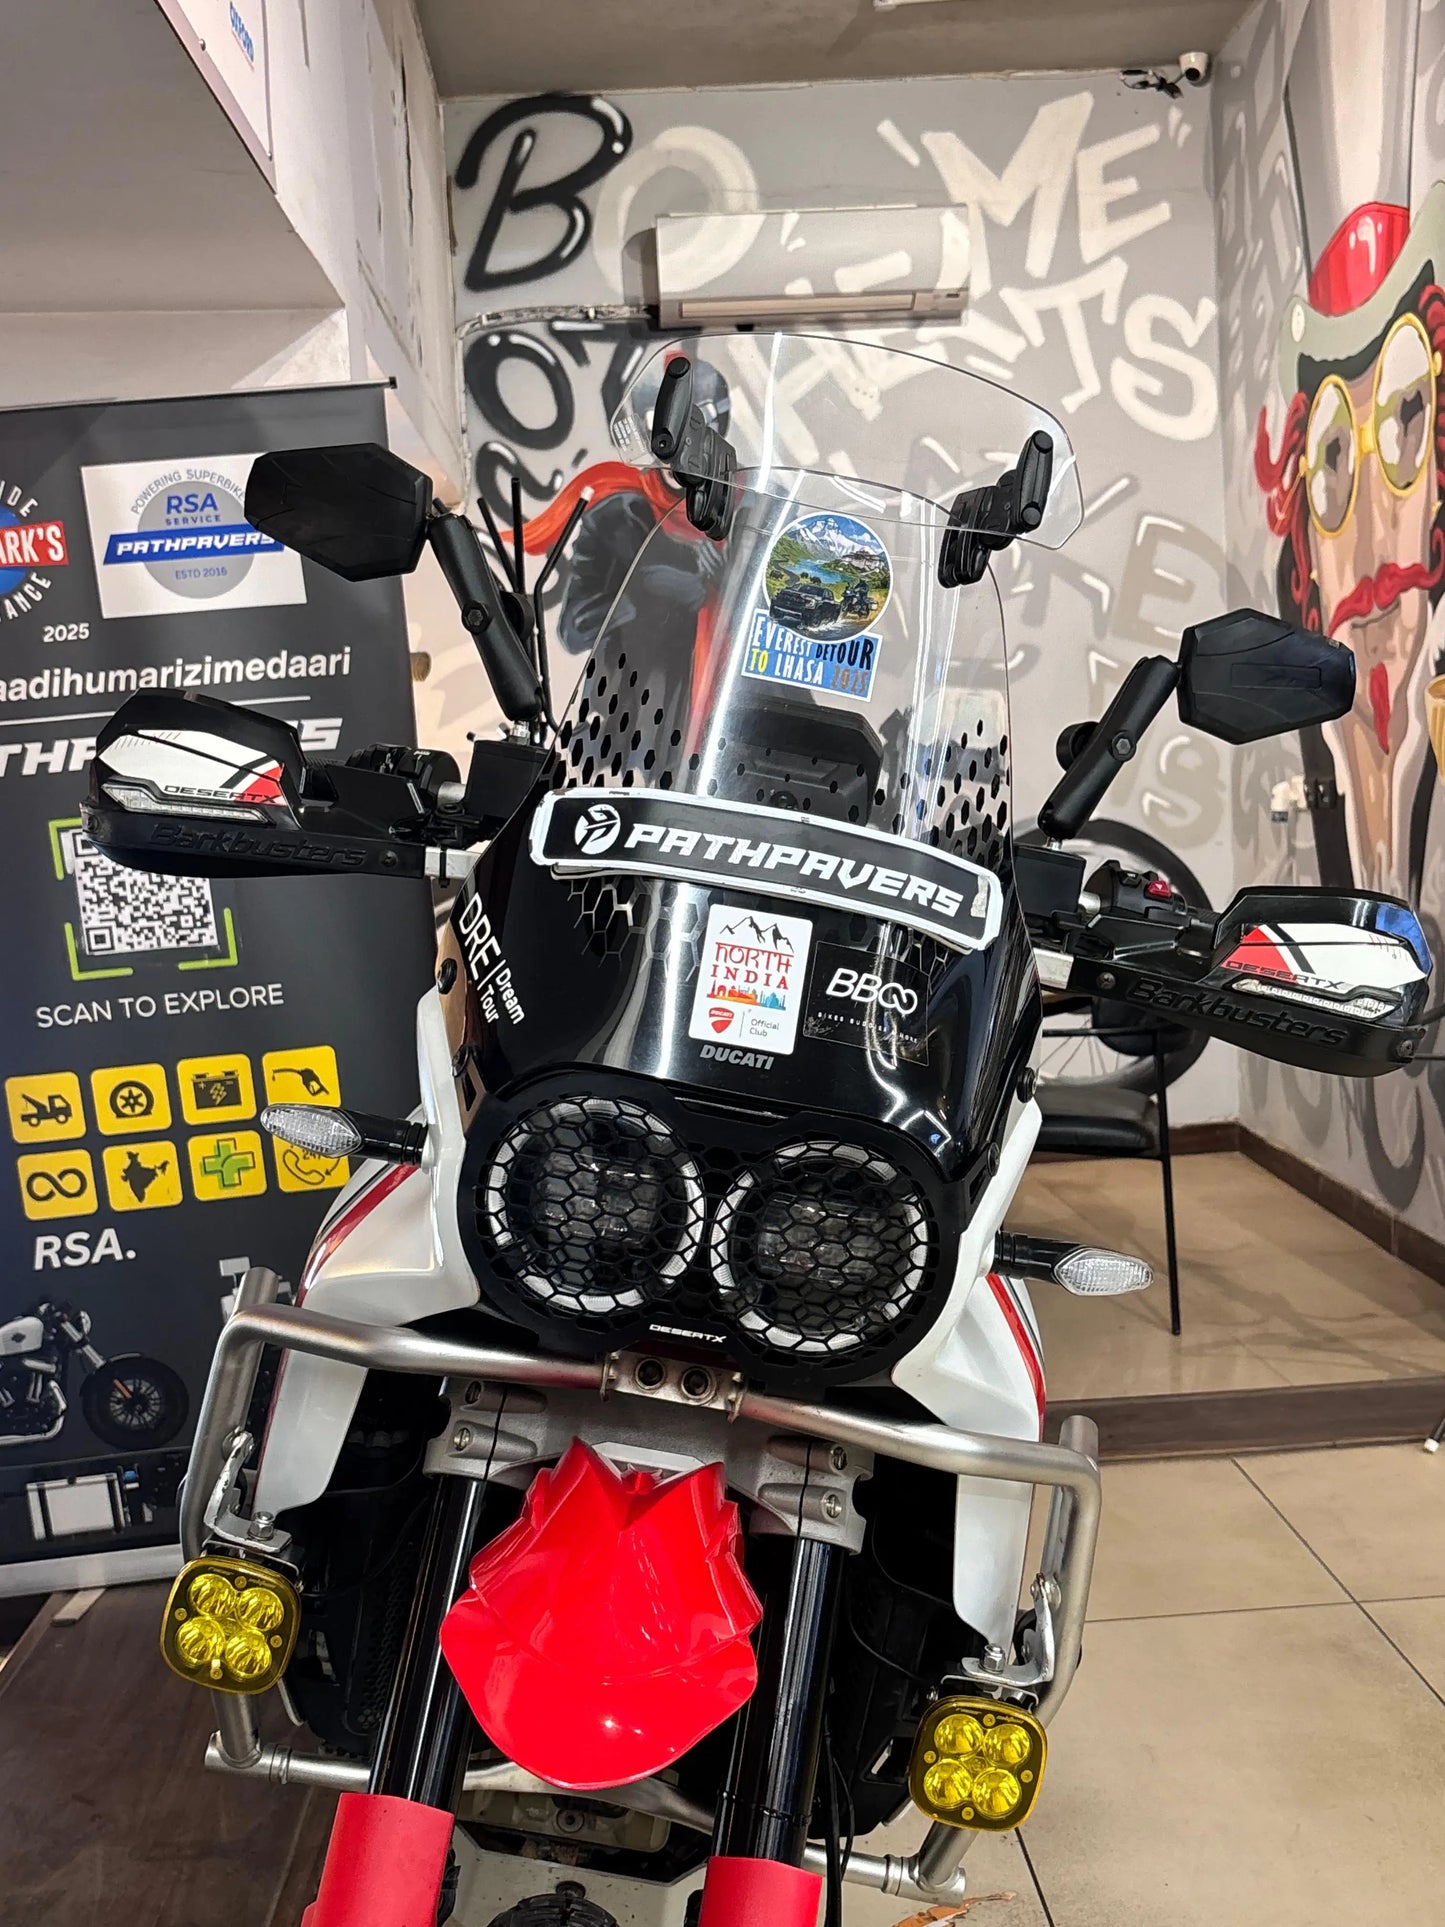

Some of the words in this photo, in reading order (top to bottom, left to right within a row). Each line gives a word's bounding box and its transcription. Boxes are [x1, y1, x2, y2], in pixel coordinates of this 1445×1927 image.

[131, 471, 183, 515] POWERING
[166, 493, 219, 515] RSA
[165, 514, 222, 526] SERVICE
[175, 569, 201, 580] ESTD
[43, 622, 90, 643] 2025
[752, 616, 813, 657] EVEREST
[816, 638, 874, 671] DETOUR
[750, 647, 769, 672] TO
[775, 654, 824, 685] LHASA
[830, 665, 868, 693] 2025
[151, 823, 367, 866] Barkbusters
[624, 822, 965, 917] PATHPAVERS
[459, 892, 501, 981] DRE
[495, 967, 525, 1025] Dream
[711, 964, 788, 990] INDIA
[36, 1001, 112, 1029] SCAN
[123, 996, 157, 1019] TO
[166, 983, 284, 1015] EXPLORE
[480, 984, 500, 1023] Tour
[751, 1018, 779, 1031] Official
[1126, 977, 1350, 1045] Barkbusters
[749, 1027, 768, 1037] Club
[700, 1044, 774, 1070] DUCATI
[33, 1228, 137, 1271] RSA.
